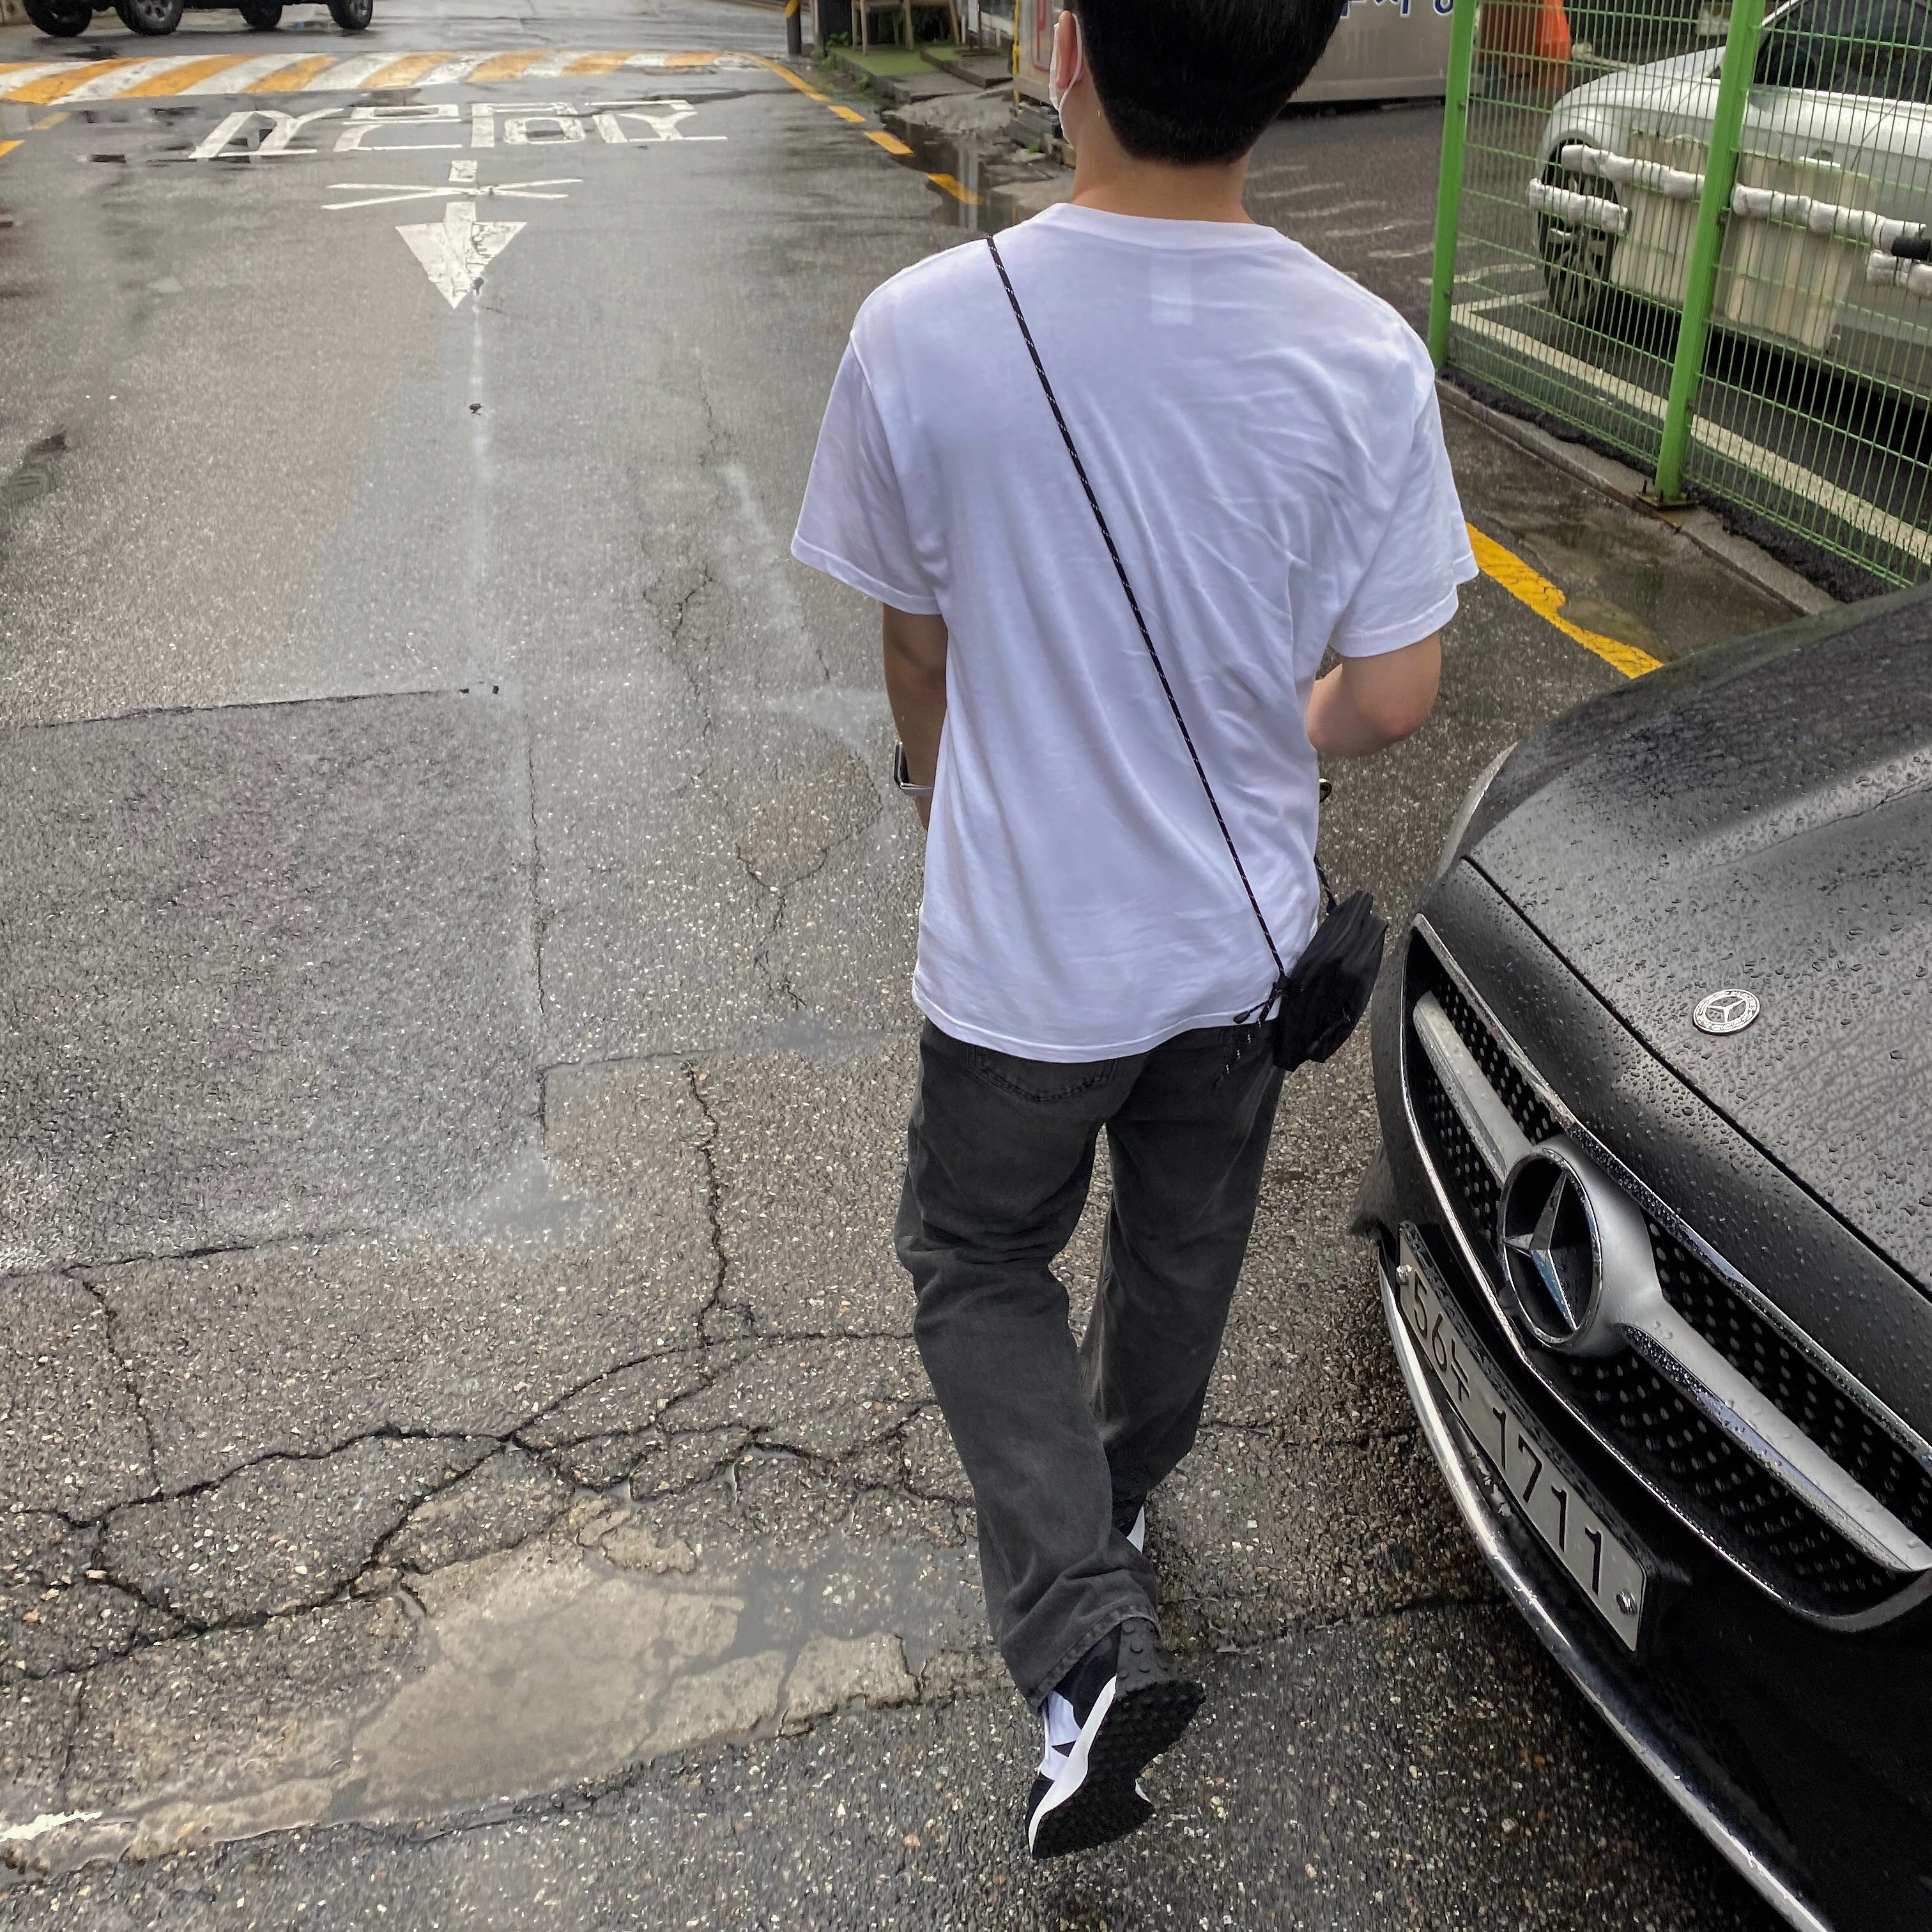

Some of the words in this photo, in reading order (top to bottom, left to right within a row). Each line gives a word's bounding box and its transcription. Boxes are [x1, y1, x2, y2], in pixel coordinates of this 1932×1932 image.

[188, 100, 728, 158] 진입금지
[1413, 1272, 1469, 1402] 56누
[1492, 1406, 1602, 1595] 1711
